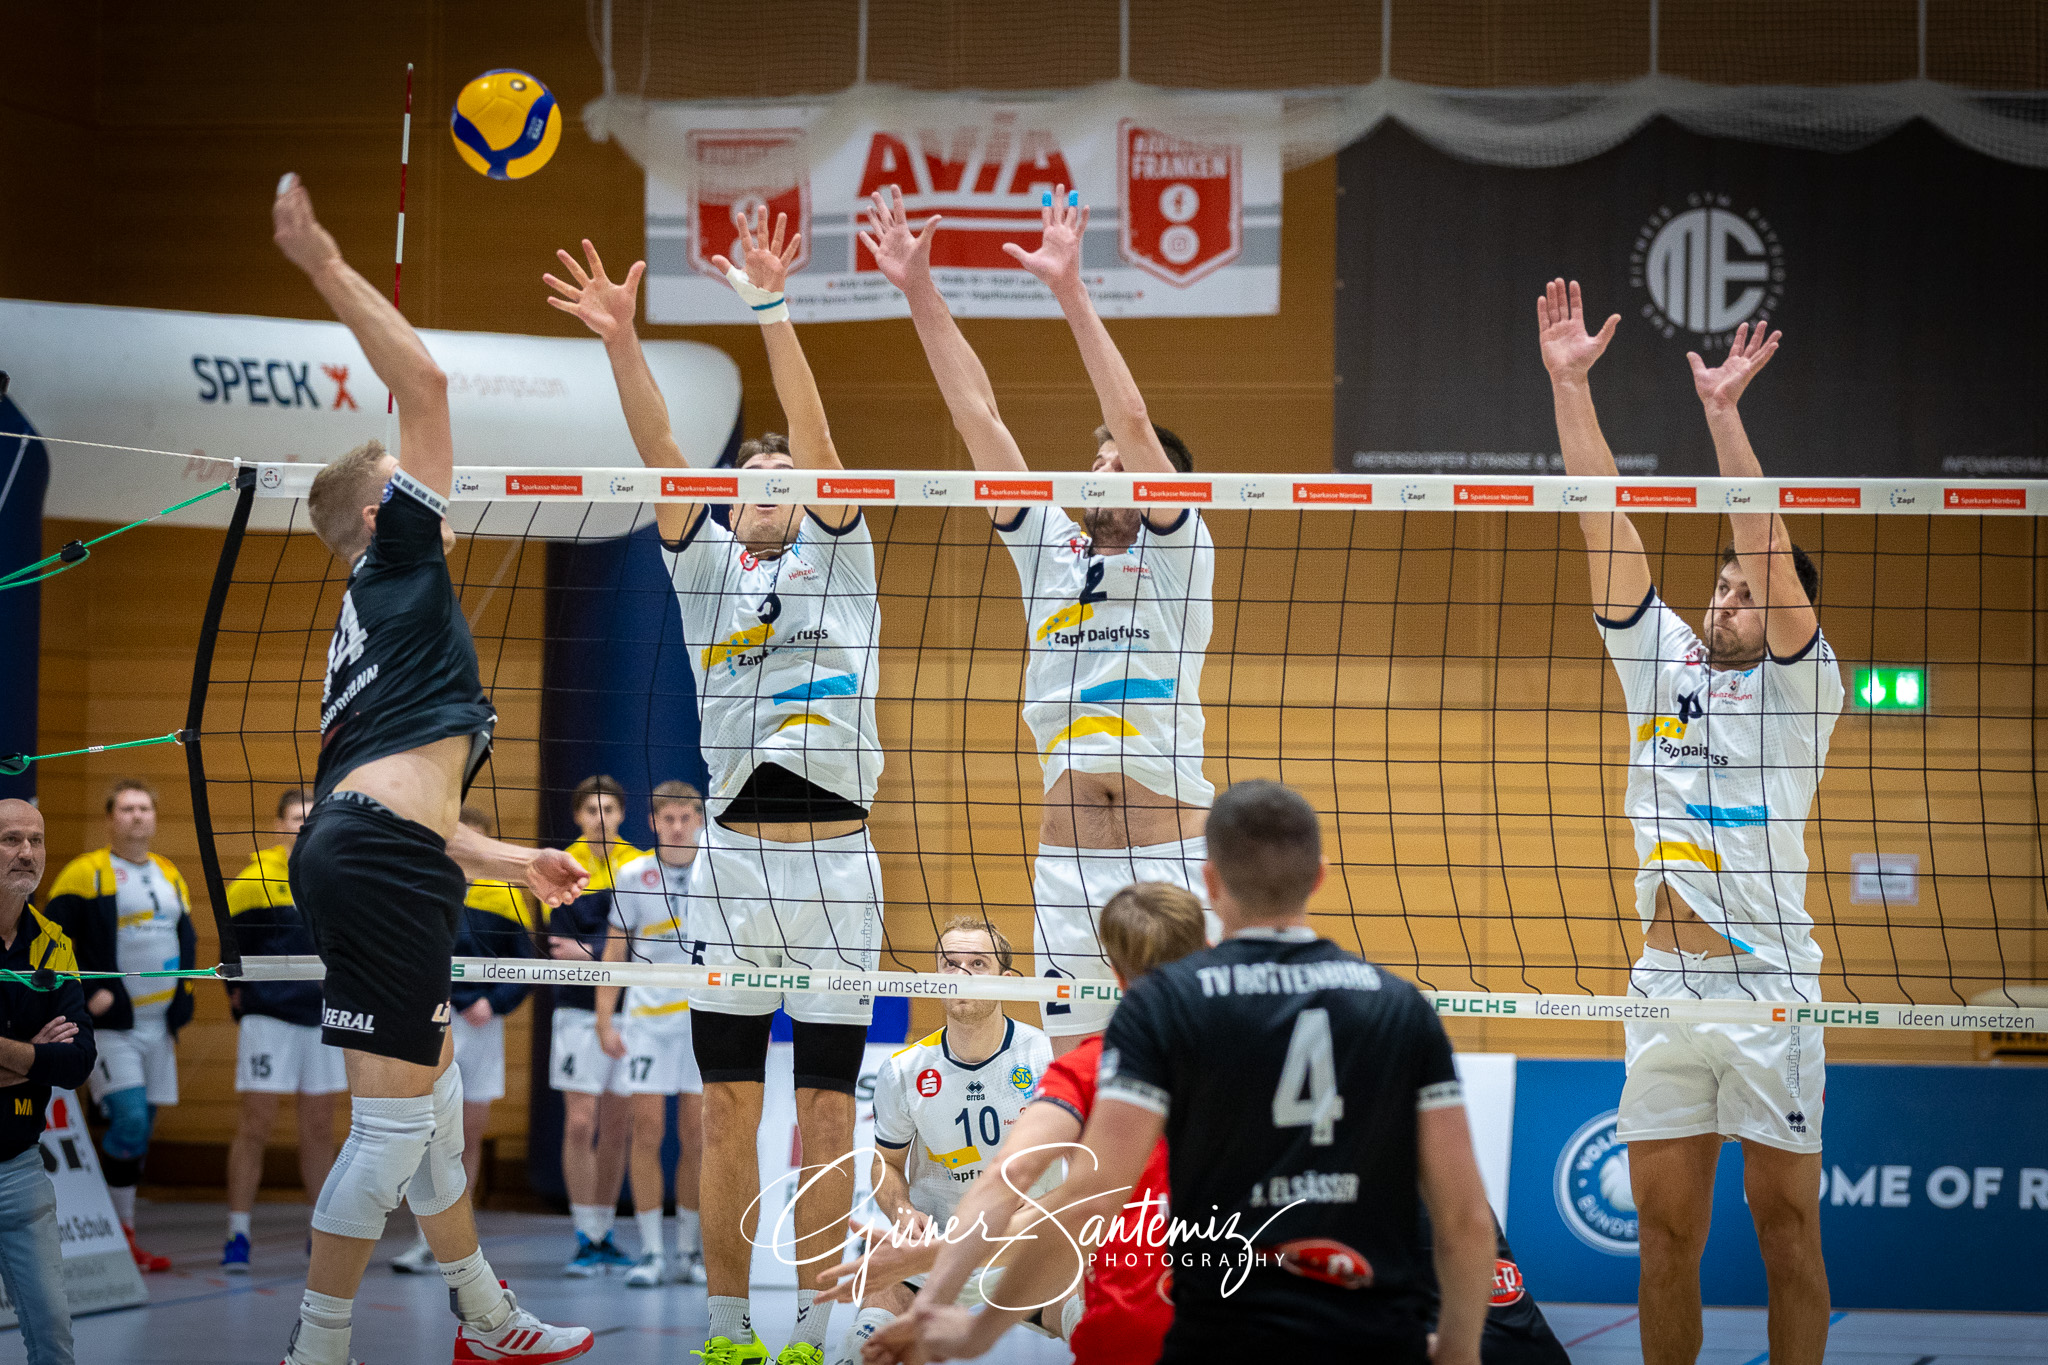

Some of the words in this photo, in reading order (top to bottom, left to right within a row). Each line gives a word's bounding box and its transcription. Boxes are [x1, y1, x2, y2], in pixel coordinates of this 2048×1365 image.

[192, 356, 320, 409] SPECK
[677, 485, 705, 493] Sparkasse
[863, 487, 890, 495] Nürnberg
[1020, 489, 1048, 497] Nürnberg
[1179, 490, 1207, 498] Nürnberg
[1339, 492, 1367, 500] Nürnberg
[1663, 495, 1691, 503] Nürnberg
[1825, 496, 1855, 504] Nürnberg
[1080, 561, 1107, 605] 2
[1054, 629, 1085, 647] Zapf
[1088, 625, 1150, 643] Daigfuss
[482, 963, 526, 980] Ideen
[532, 966, 611, 982] umsetzen
[1196, 965, 1231, 997] TV
[731, 973, 810, 989] FUCHS
[828, 976, 872, 992] Ideen
[878, 979, 958, 995] umsetzen
[1081, 985, 1123, 1000] FUC
[1435, 998, 1517, 1014] FUCHS
[1535, 1000, 1580, 1017] Ideen
[1587, 1003, 1670, 1019] umsetzen
[1797, 1008, 1879, 1024] FUCHS
[1898, 1010, 1944, 1027] Ideen
[1950, 1013, 2035, 1029] umsetzen
[629, 1055, 654, 1082] 17
[1272, 1007, 1344, 1146] 4
[955, 1105, 1001, 1147] 10
[1926, 1165, 2004, 1209] OF
